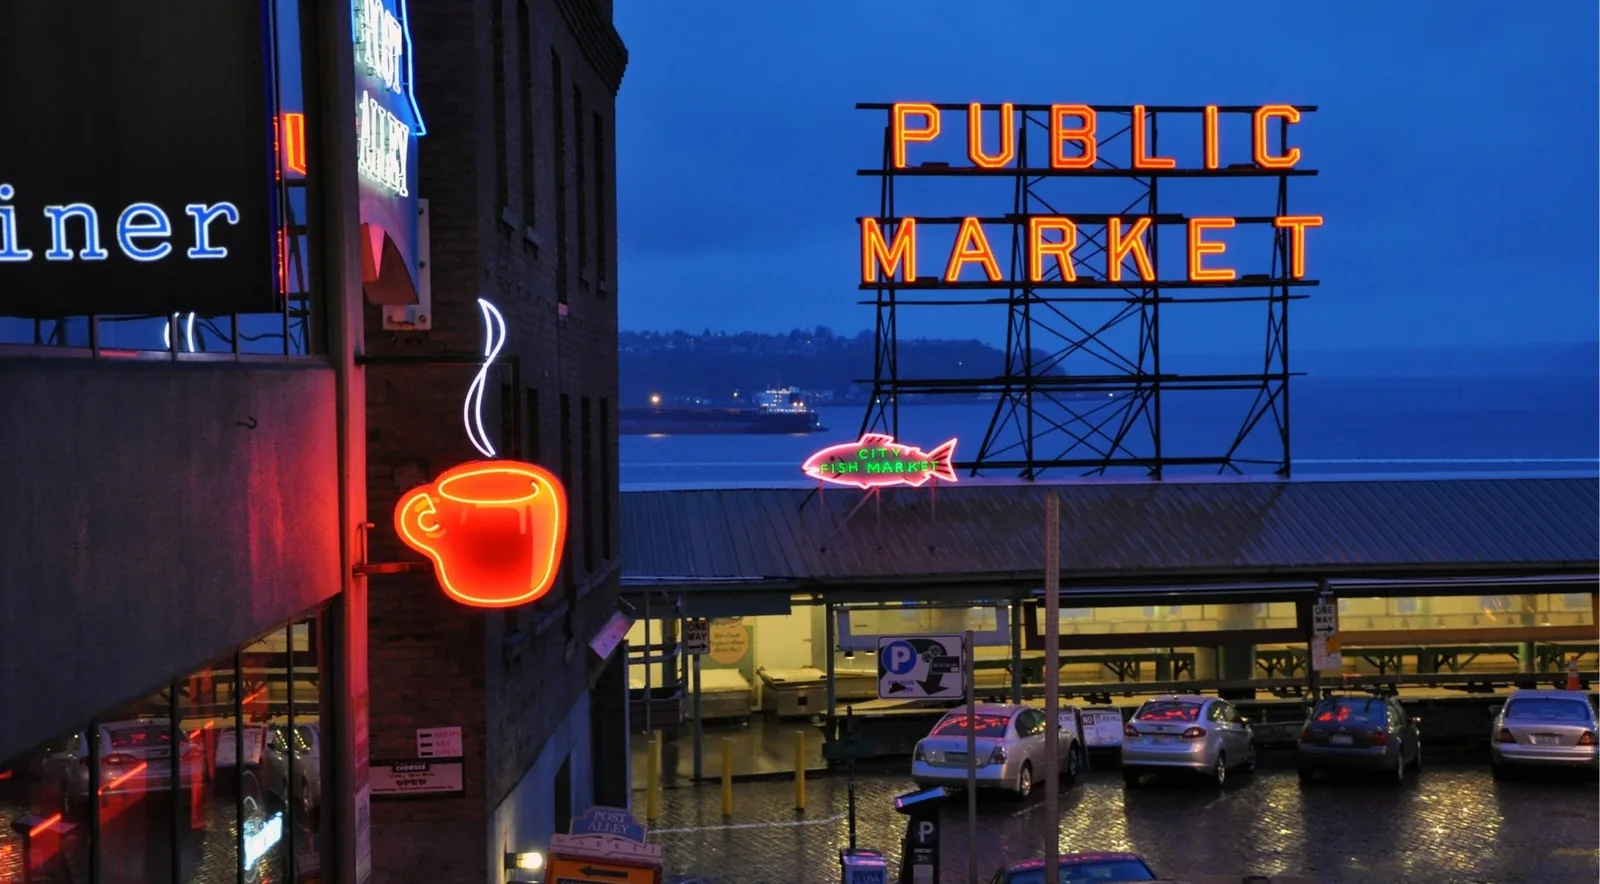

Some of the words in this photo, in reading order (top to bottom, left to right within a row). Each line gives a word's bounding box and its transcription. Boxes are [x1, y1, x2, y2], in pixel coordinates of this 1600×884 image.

[892, 102, 1301, 170] PUBLIC
[357, 89, 409, 197] ALLEY
[0, 183, 240, 261] iner
[860, 216, 1323, 283] MARKET
[858, 447, 900, 460] CITY
[820, 461, 859, 474] FISH
[866, 460, 940, 474] MARKET
[1315, 606, 1332, 615] ONE
[688, 622, 707, 631] ONE
[1315, 616, 1333, 624] WAY
[688, 632, 707, 640] WAY
[891, 645, 911, 672] P
[1082, 715, 1093, 725] NO
[594, 811, 628, 823] POST
[588, 821, 629, 834] ALLEY
